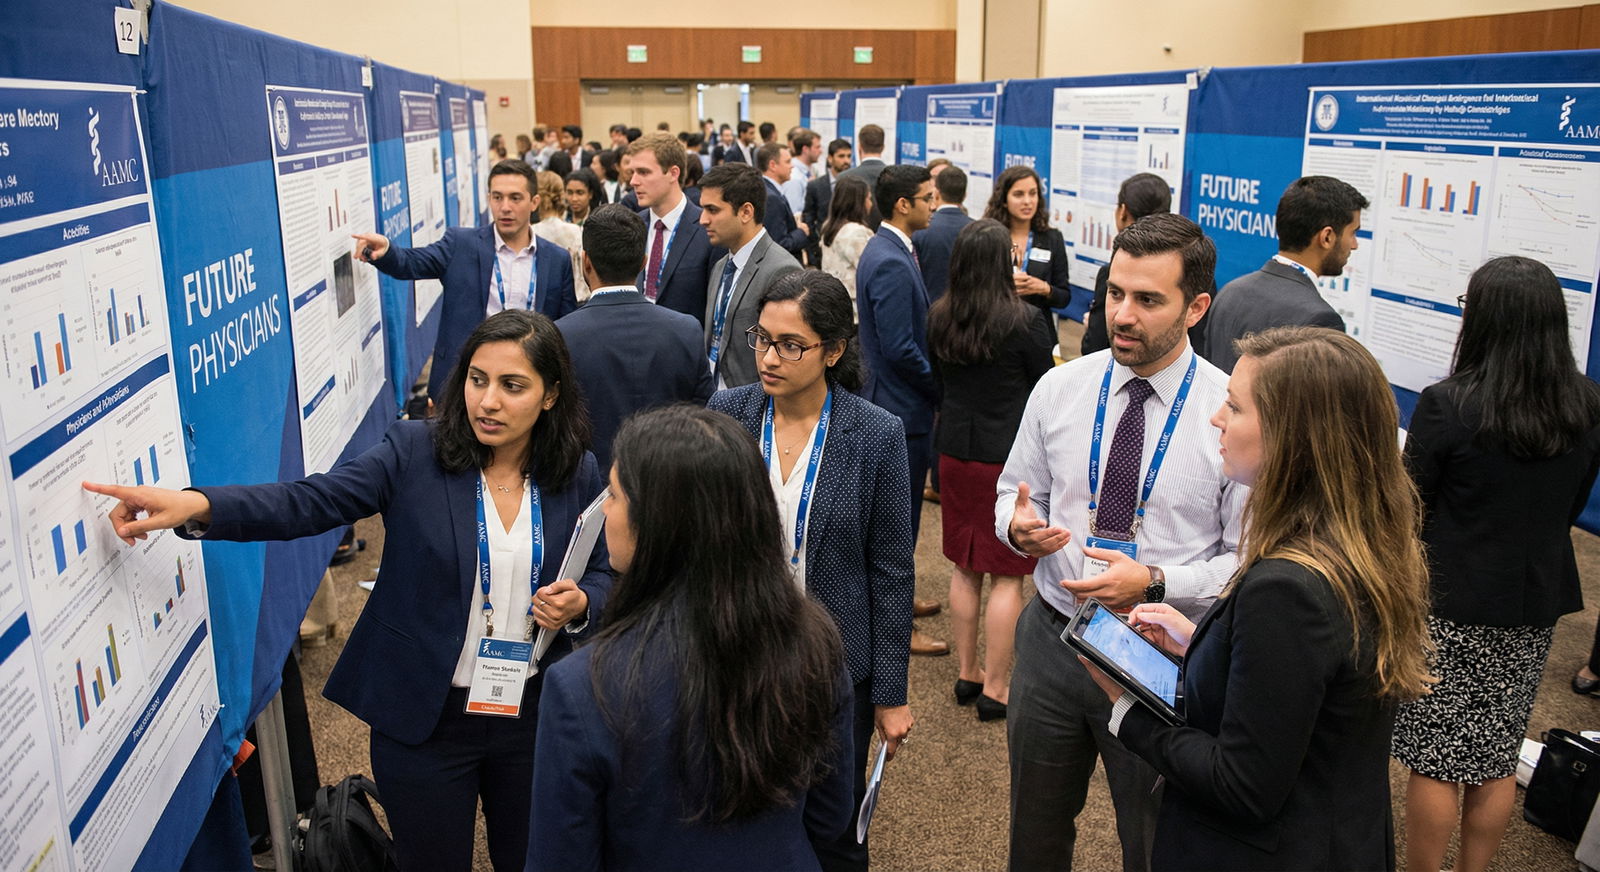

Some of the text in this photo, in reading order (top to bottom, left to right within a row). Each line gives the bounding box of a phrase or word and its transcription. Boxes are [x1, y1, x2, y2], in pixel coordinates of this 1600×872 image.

[120, 21, 133, 42] 12
[17, 108, 59, 131] Mectory
[1565, 124, 1600, 139] AAM
[102, 158, 139, 187] AAMC
[1200, 173, 1261, 205] FUTURE
[1198, 203, 1279, 240] PHYSICIAN
[183, 248, 256, 326] FUTURE
[189, 293, 281, 394] PHYSICIANS
[1172, 397, 1184, 419] AAMC
[820, 410, 830, 430] AAMC
[1159, 432, 1171, 453] AAMC
[812, 445, 821, 466] AAMC
[1146, 468, 1157, 489] AAMC
[803, 482, 812, 501] AAMC
[477, 521, 487, 543] AAMC
[533, 523, 541, 545] AAMC
[532, 563, 540, 584] AAMC
